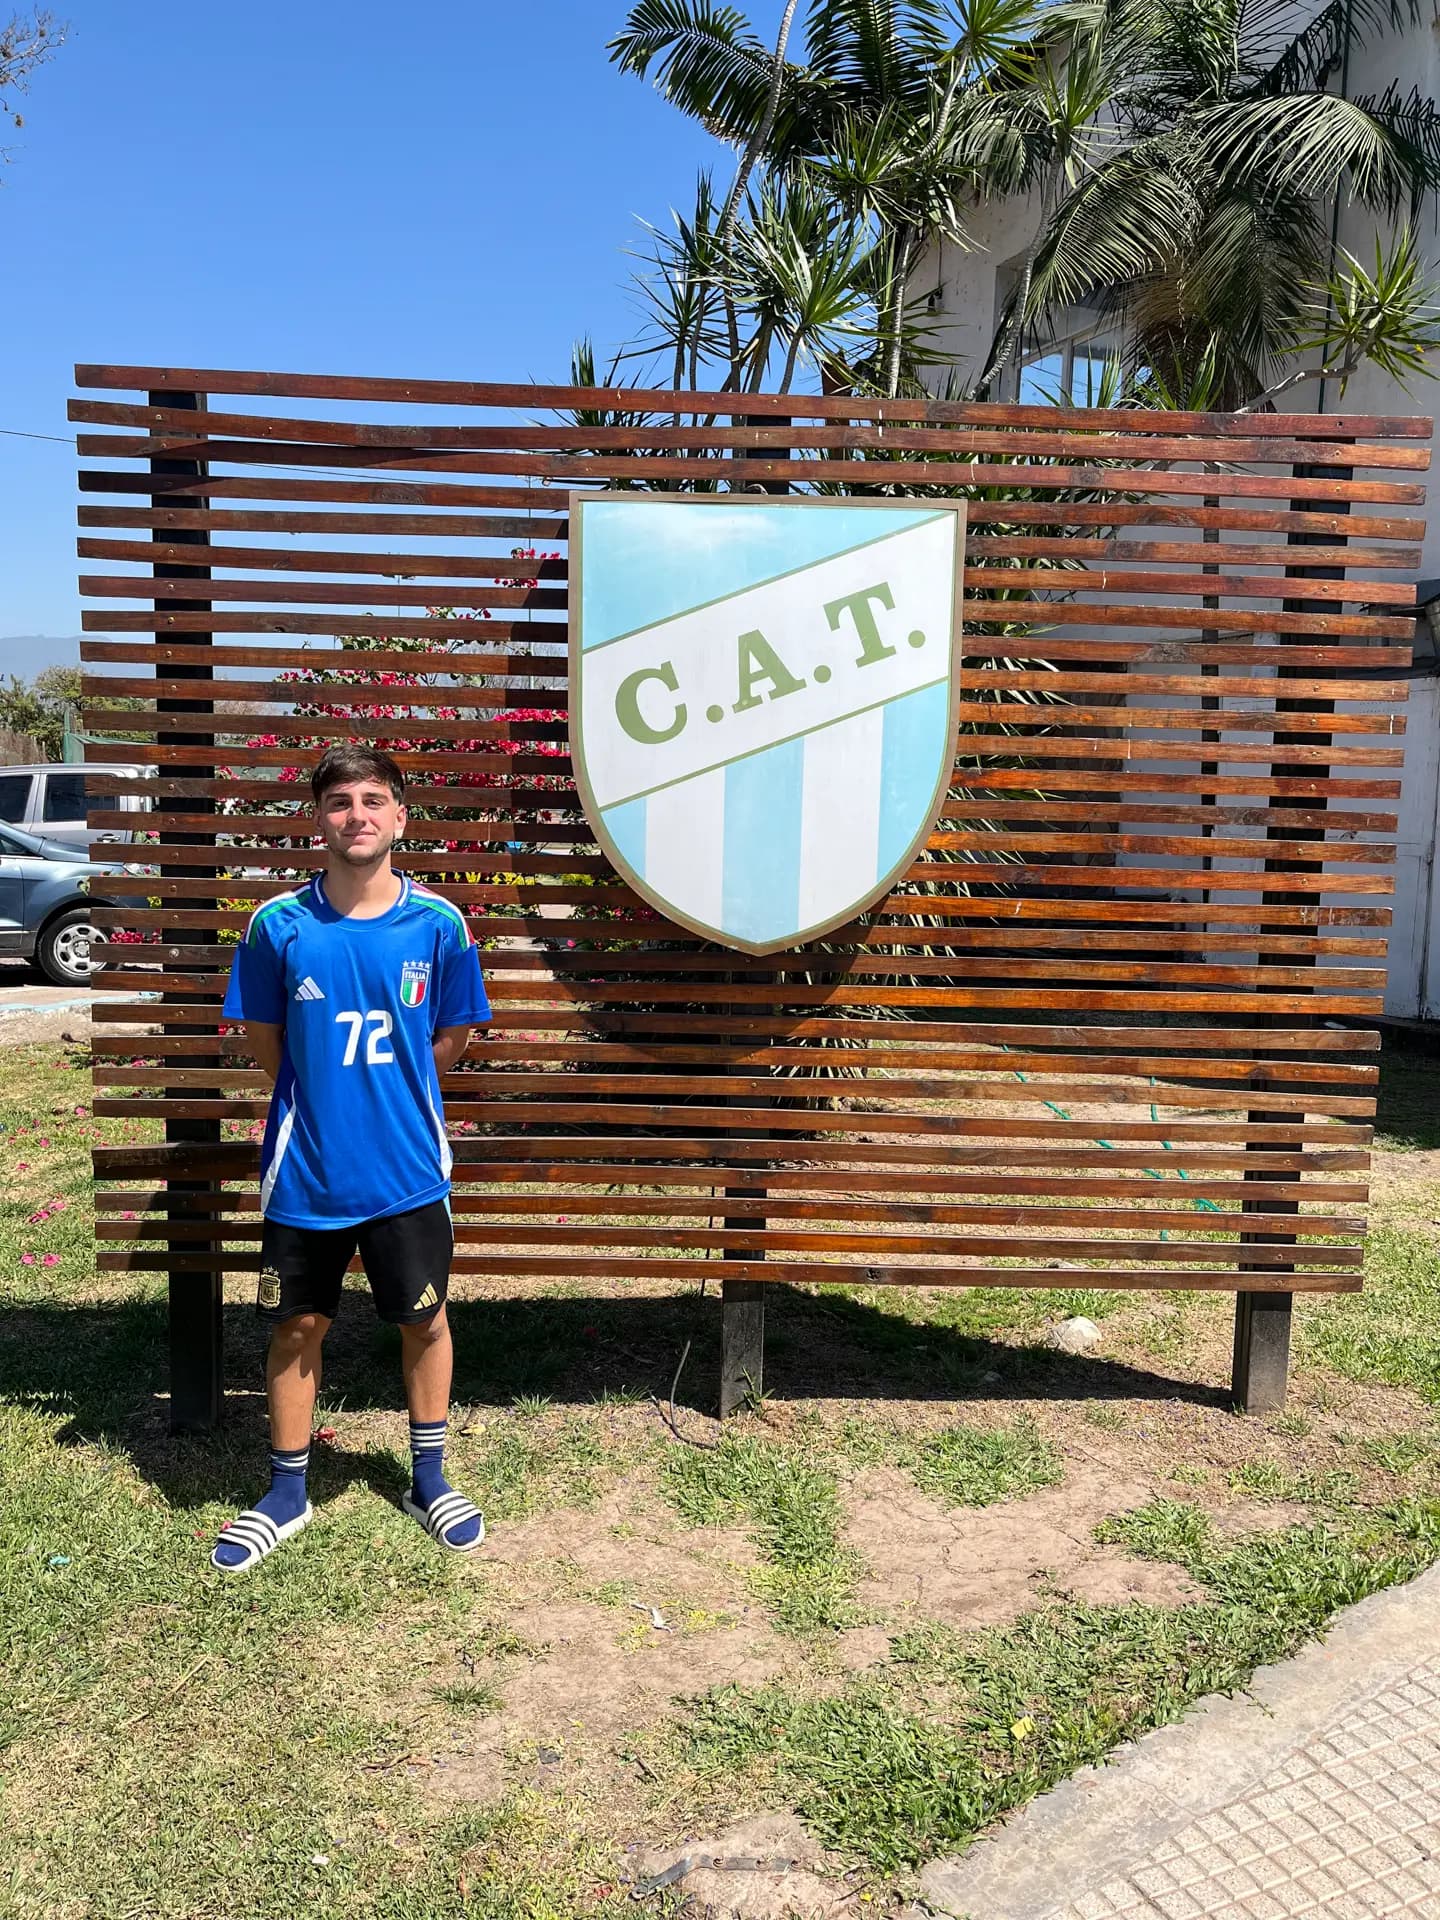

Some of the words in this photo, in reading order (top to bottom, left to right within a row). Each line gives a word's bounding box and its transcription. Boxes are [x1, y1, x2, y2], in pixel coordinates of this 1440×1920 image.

[615, 581, 926, 744] C.A.T.
[405, 971, 426, 980] ITALIA
[335, 1010, 394, 1066] 72
